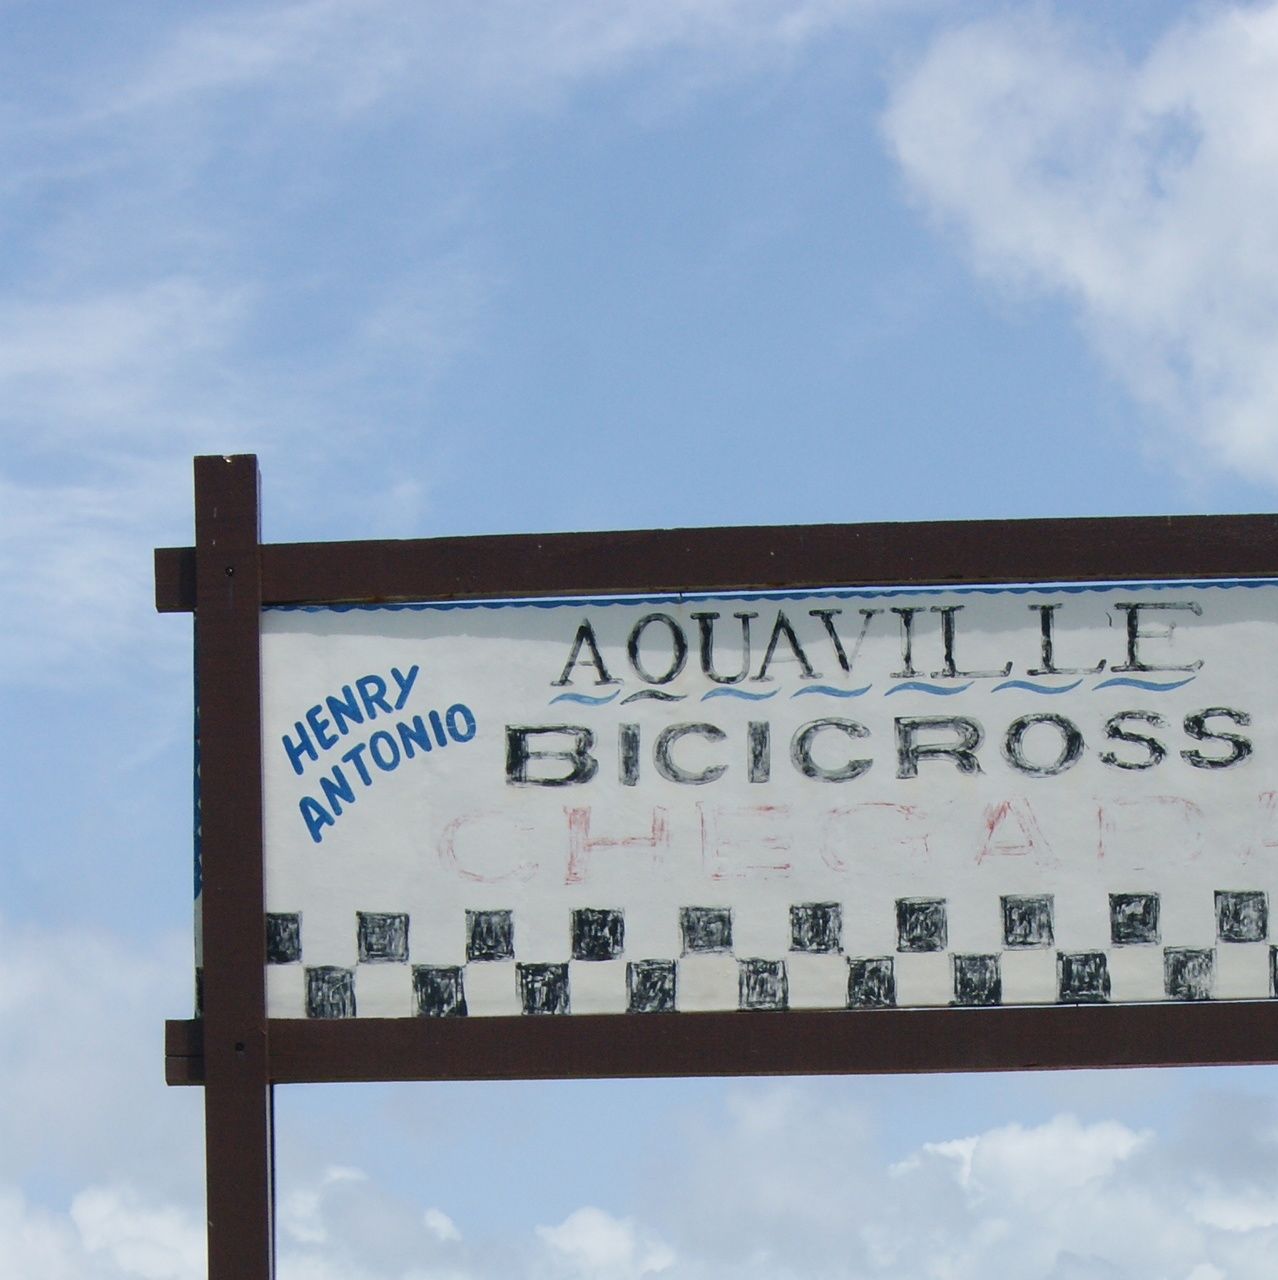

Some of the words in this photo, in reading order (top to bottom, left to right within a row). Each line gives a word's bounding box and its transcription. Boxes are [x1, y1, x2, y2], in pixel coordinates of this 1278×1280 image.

[549, 602, 1204, 687] AQUAVILLE
[282, 664, 420, 775] HENRY
[504, 706, 1255, 787] BICICROSS
[298, 703, 478, 844] ANTONIO
